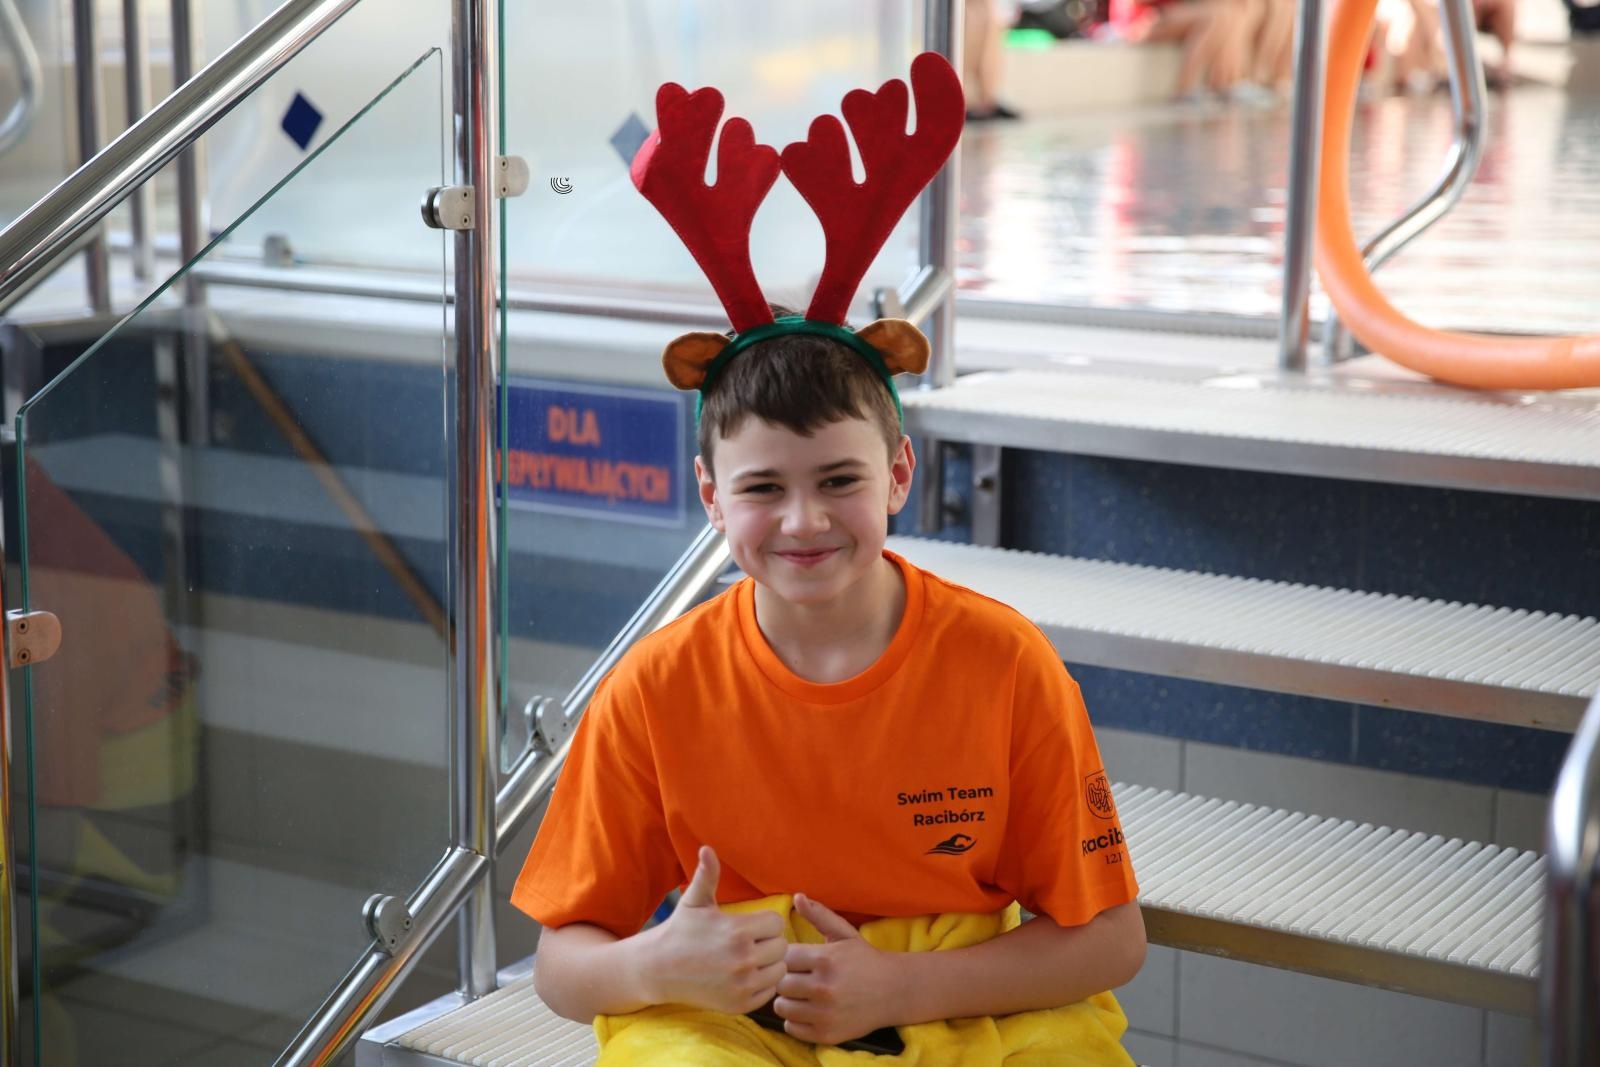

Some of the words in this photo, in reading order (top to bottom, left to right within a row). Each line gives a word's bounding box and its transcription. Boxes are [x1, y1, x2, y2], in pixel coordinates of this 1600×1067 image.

[547, 405, 600, 445] DLA
[897, 789, 943, 806] Swim
[947, 786, 993, 801] Team
[913, 809, 985, 827] Racibórz
[1082, 827, 1124, 857] Racib
